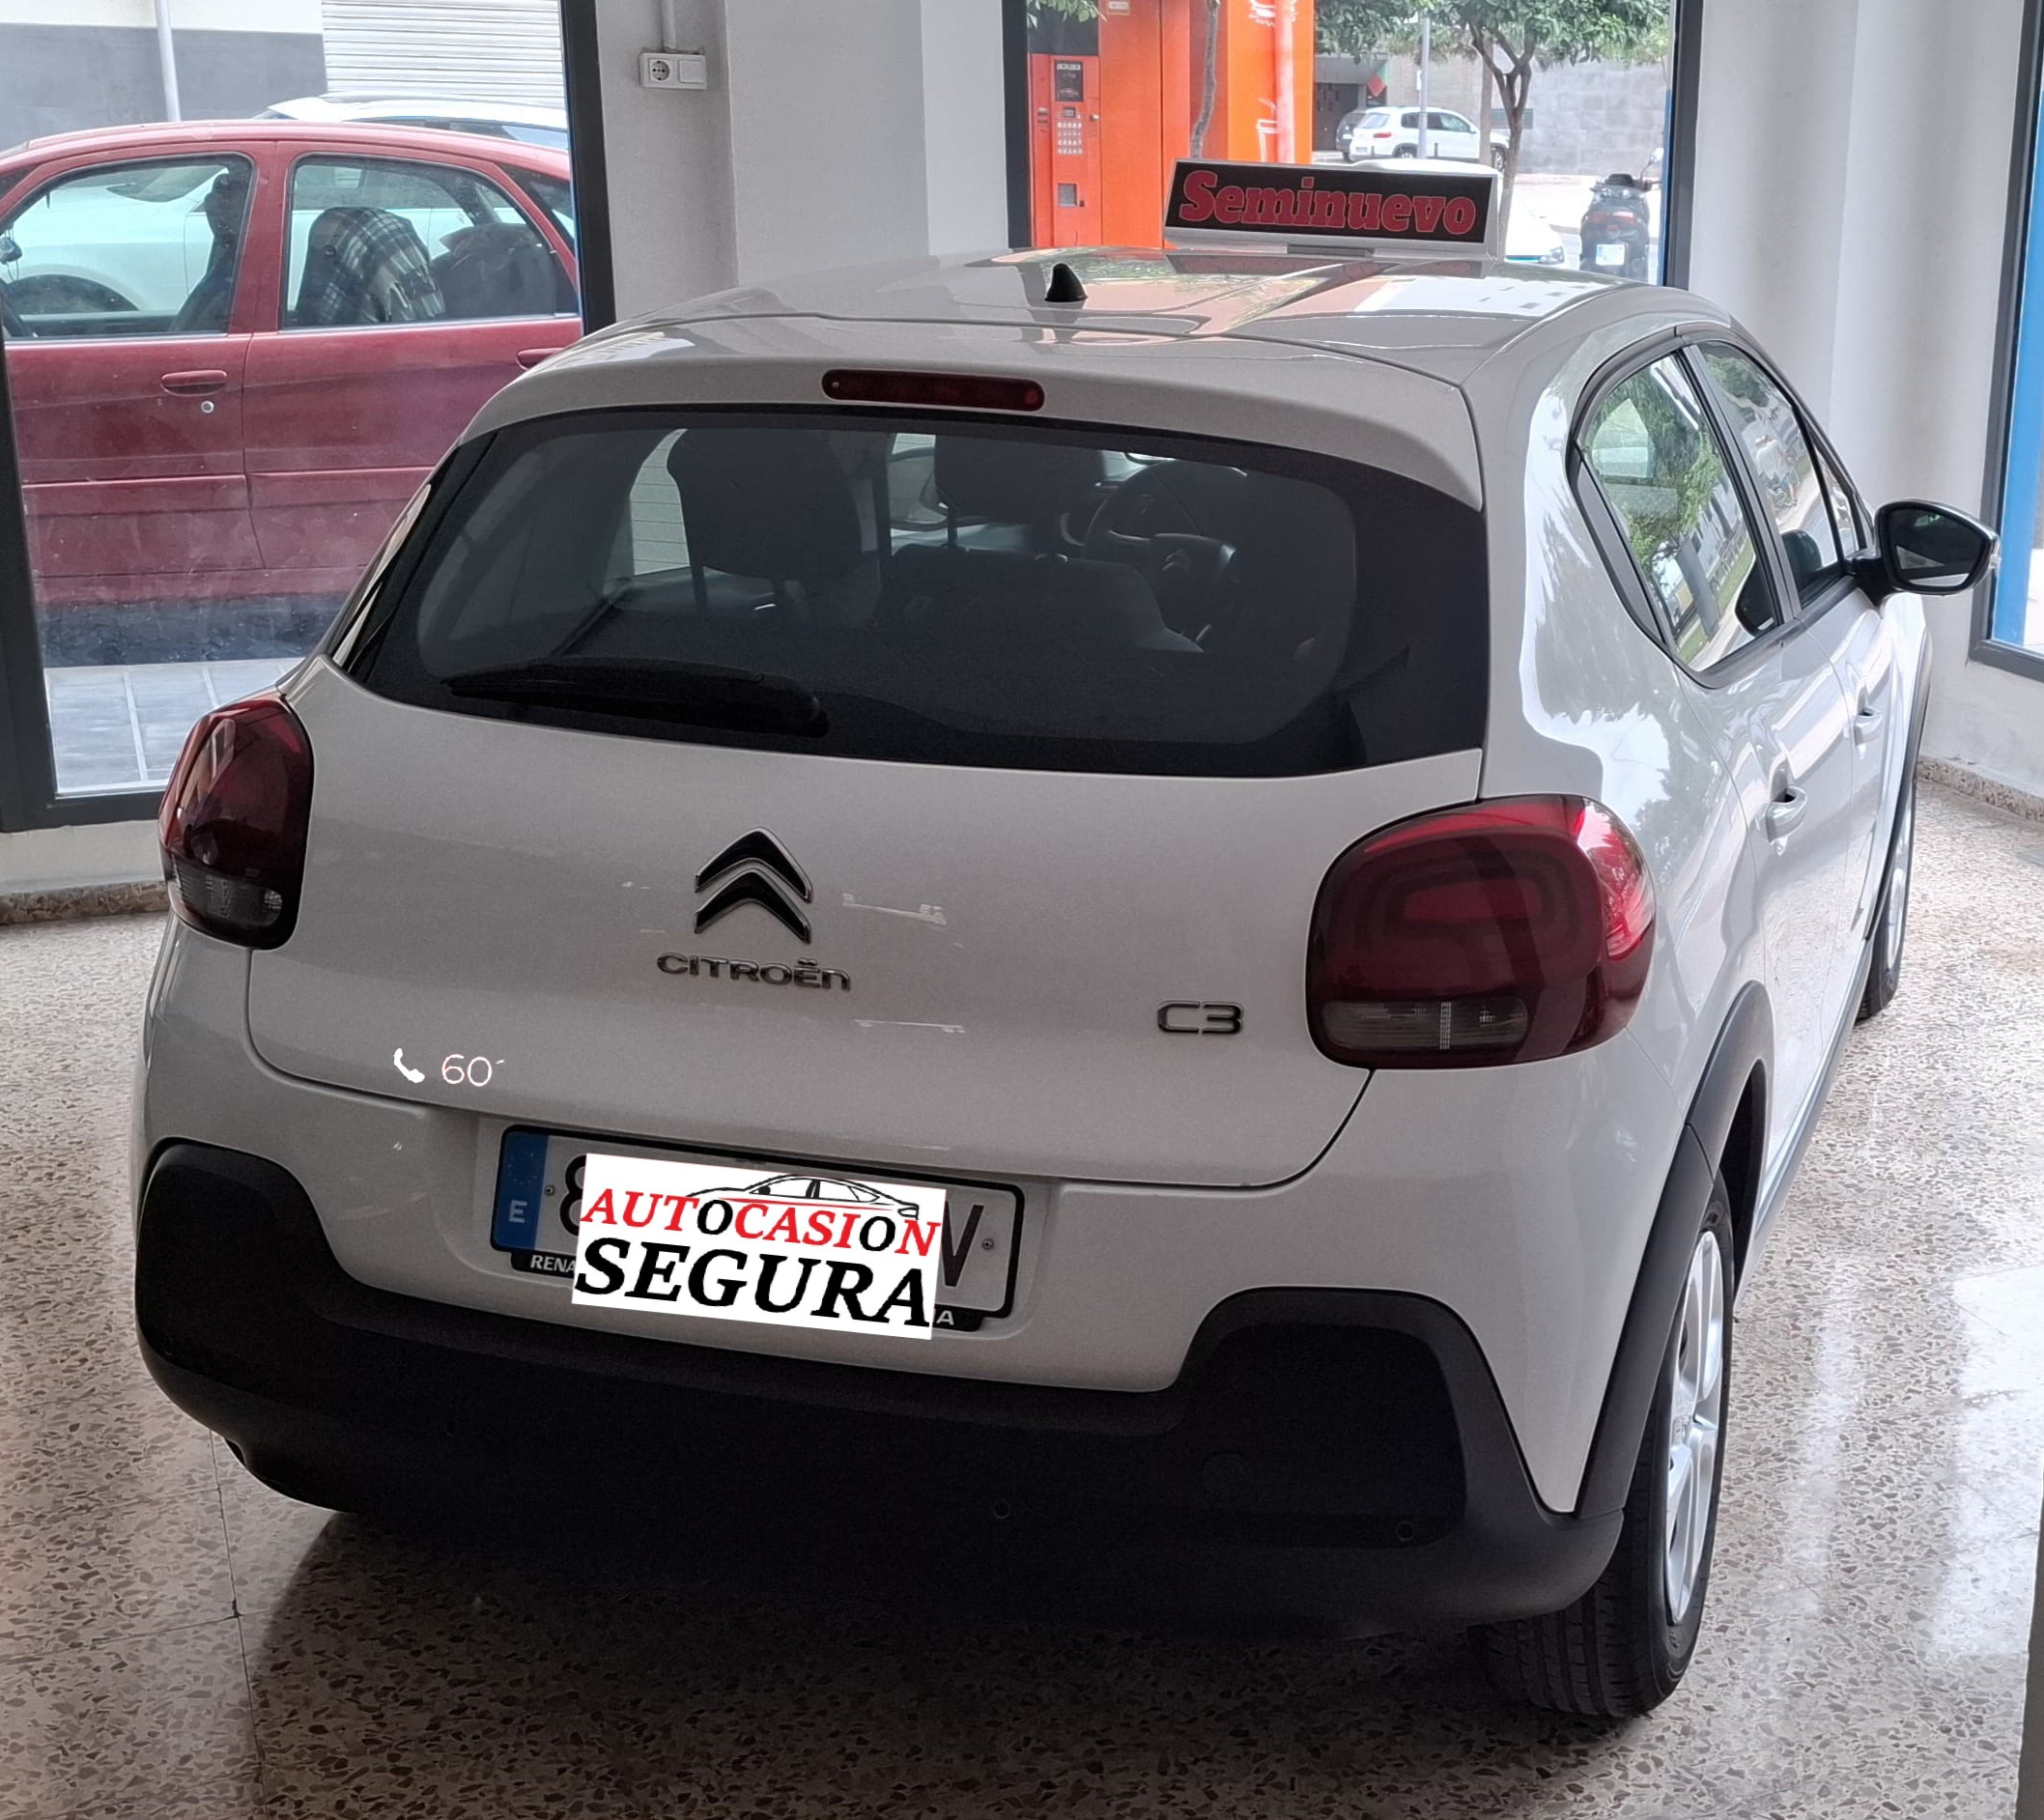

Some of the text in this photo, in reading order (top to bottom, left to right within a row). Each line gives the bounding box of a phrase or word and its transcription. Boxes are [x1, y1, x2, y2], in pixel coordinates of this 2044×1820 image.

[1178, 170, 1477, 235] Seminuevo
[1157, 1000, 1243, 1035] C3
[508, 1200, 527, 1223] E
